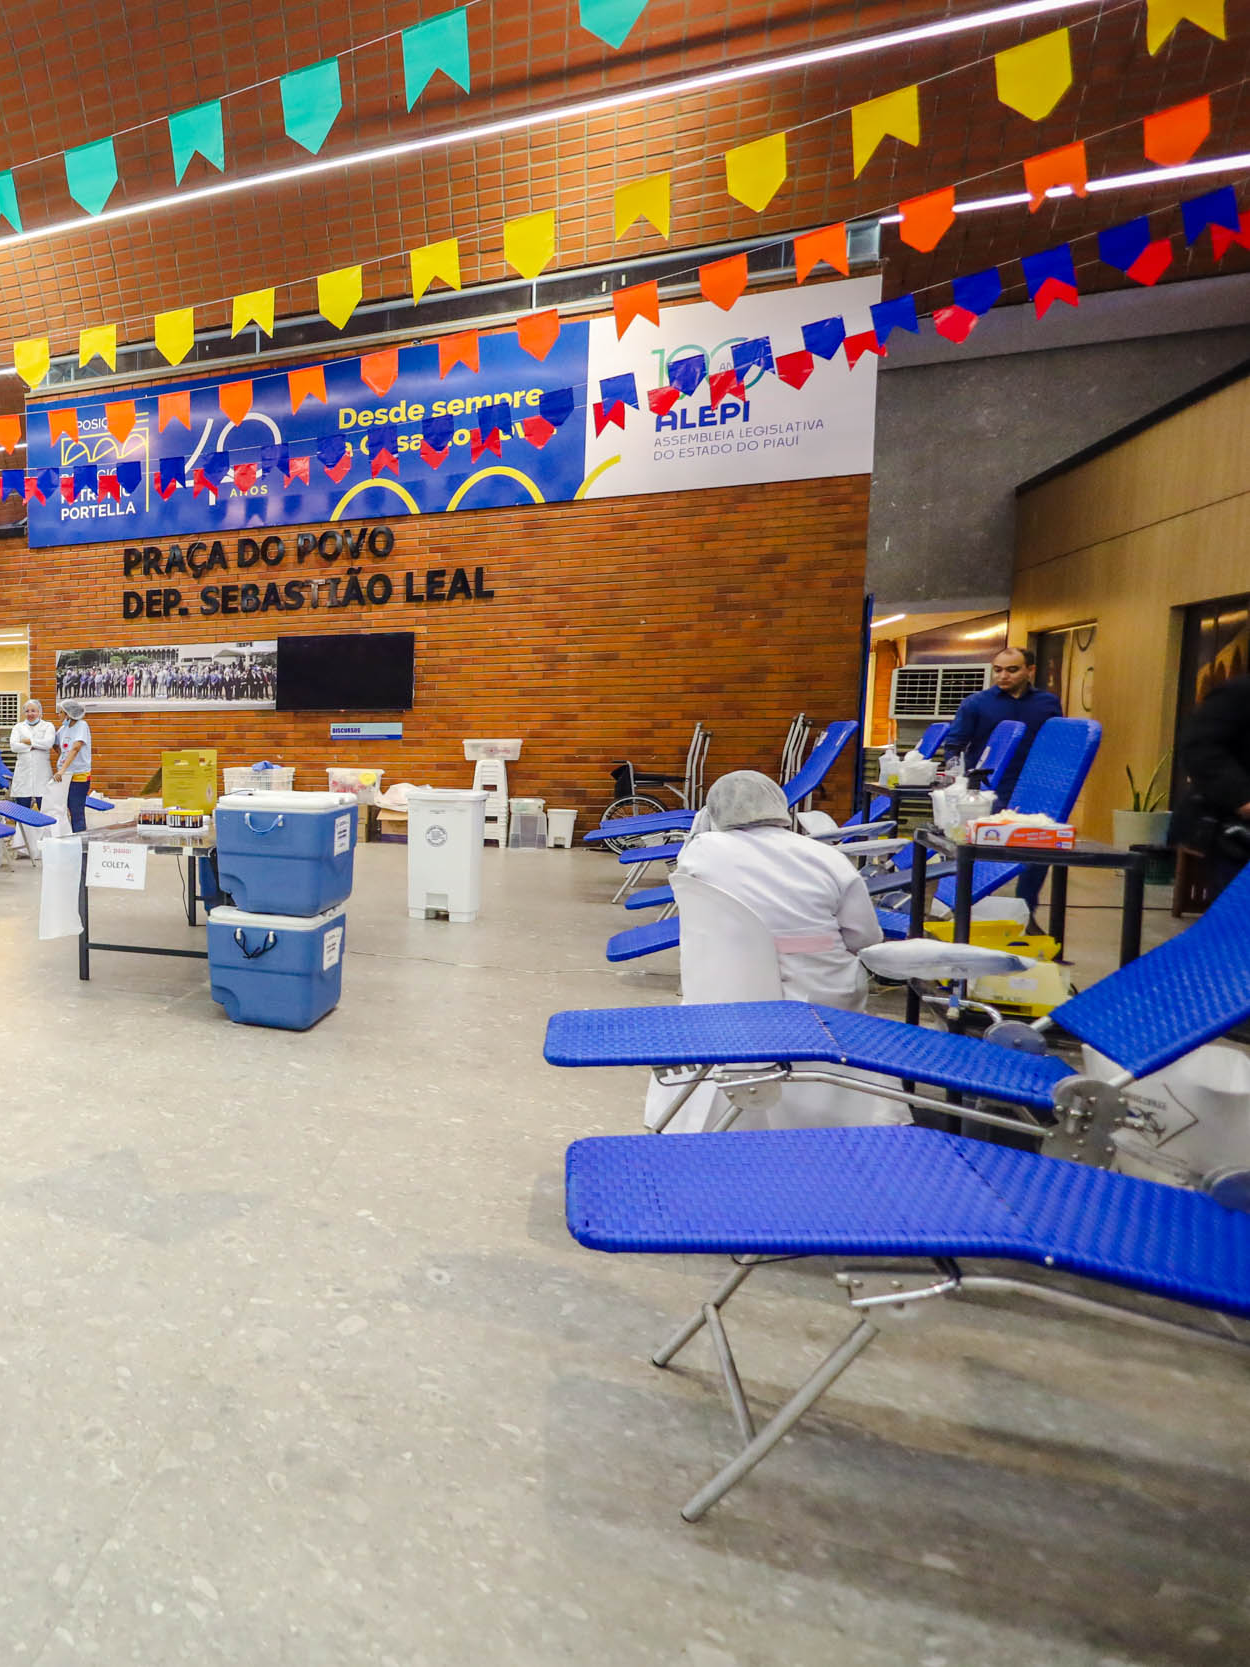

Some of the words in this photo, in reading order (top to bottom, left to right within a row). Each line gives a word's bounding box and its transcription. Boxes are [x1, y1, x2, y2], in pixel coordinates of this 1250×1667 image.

[338, 400, 425, 430] Desde
[655, 400, 750, 433] ALEPI
[653, 429, 735, 448] ASSEMBLEIA
[739, 418, 825, 439] LEGISLATIVA
[653, 449, 675, 461] DO
[679, 443, 733, 459] ESTADO
[736, 440, 759, 452] DO
[763, 434, 799, 449] PIAUÍ
[61, 501, 136, 521] PORTELLA
[123, 539, 227, 579] PRAÇA
[237, 536, 284, 568] DO
[297, 526, 394, 563] POVO
[123, 589, 189, 619] DEP.
[200, 567, 393, 615] SEBASTIÃO
[405, 567, 495, 602] LEAL
[101, 860, 130, 869] COLETA
